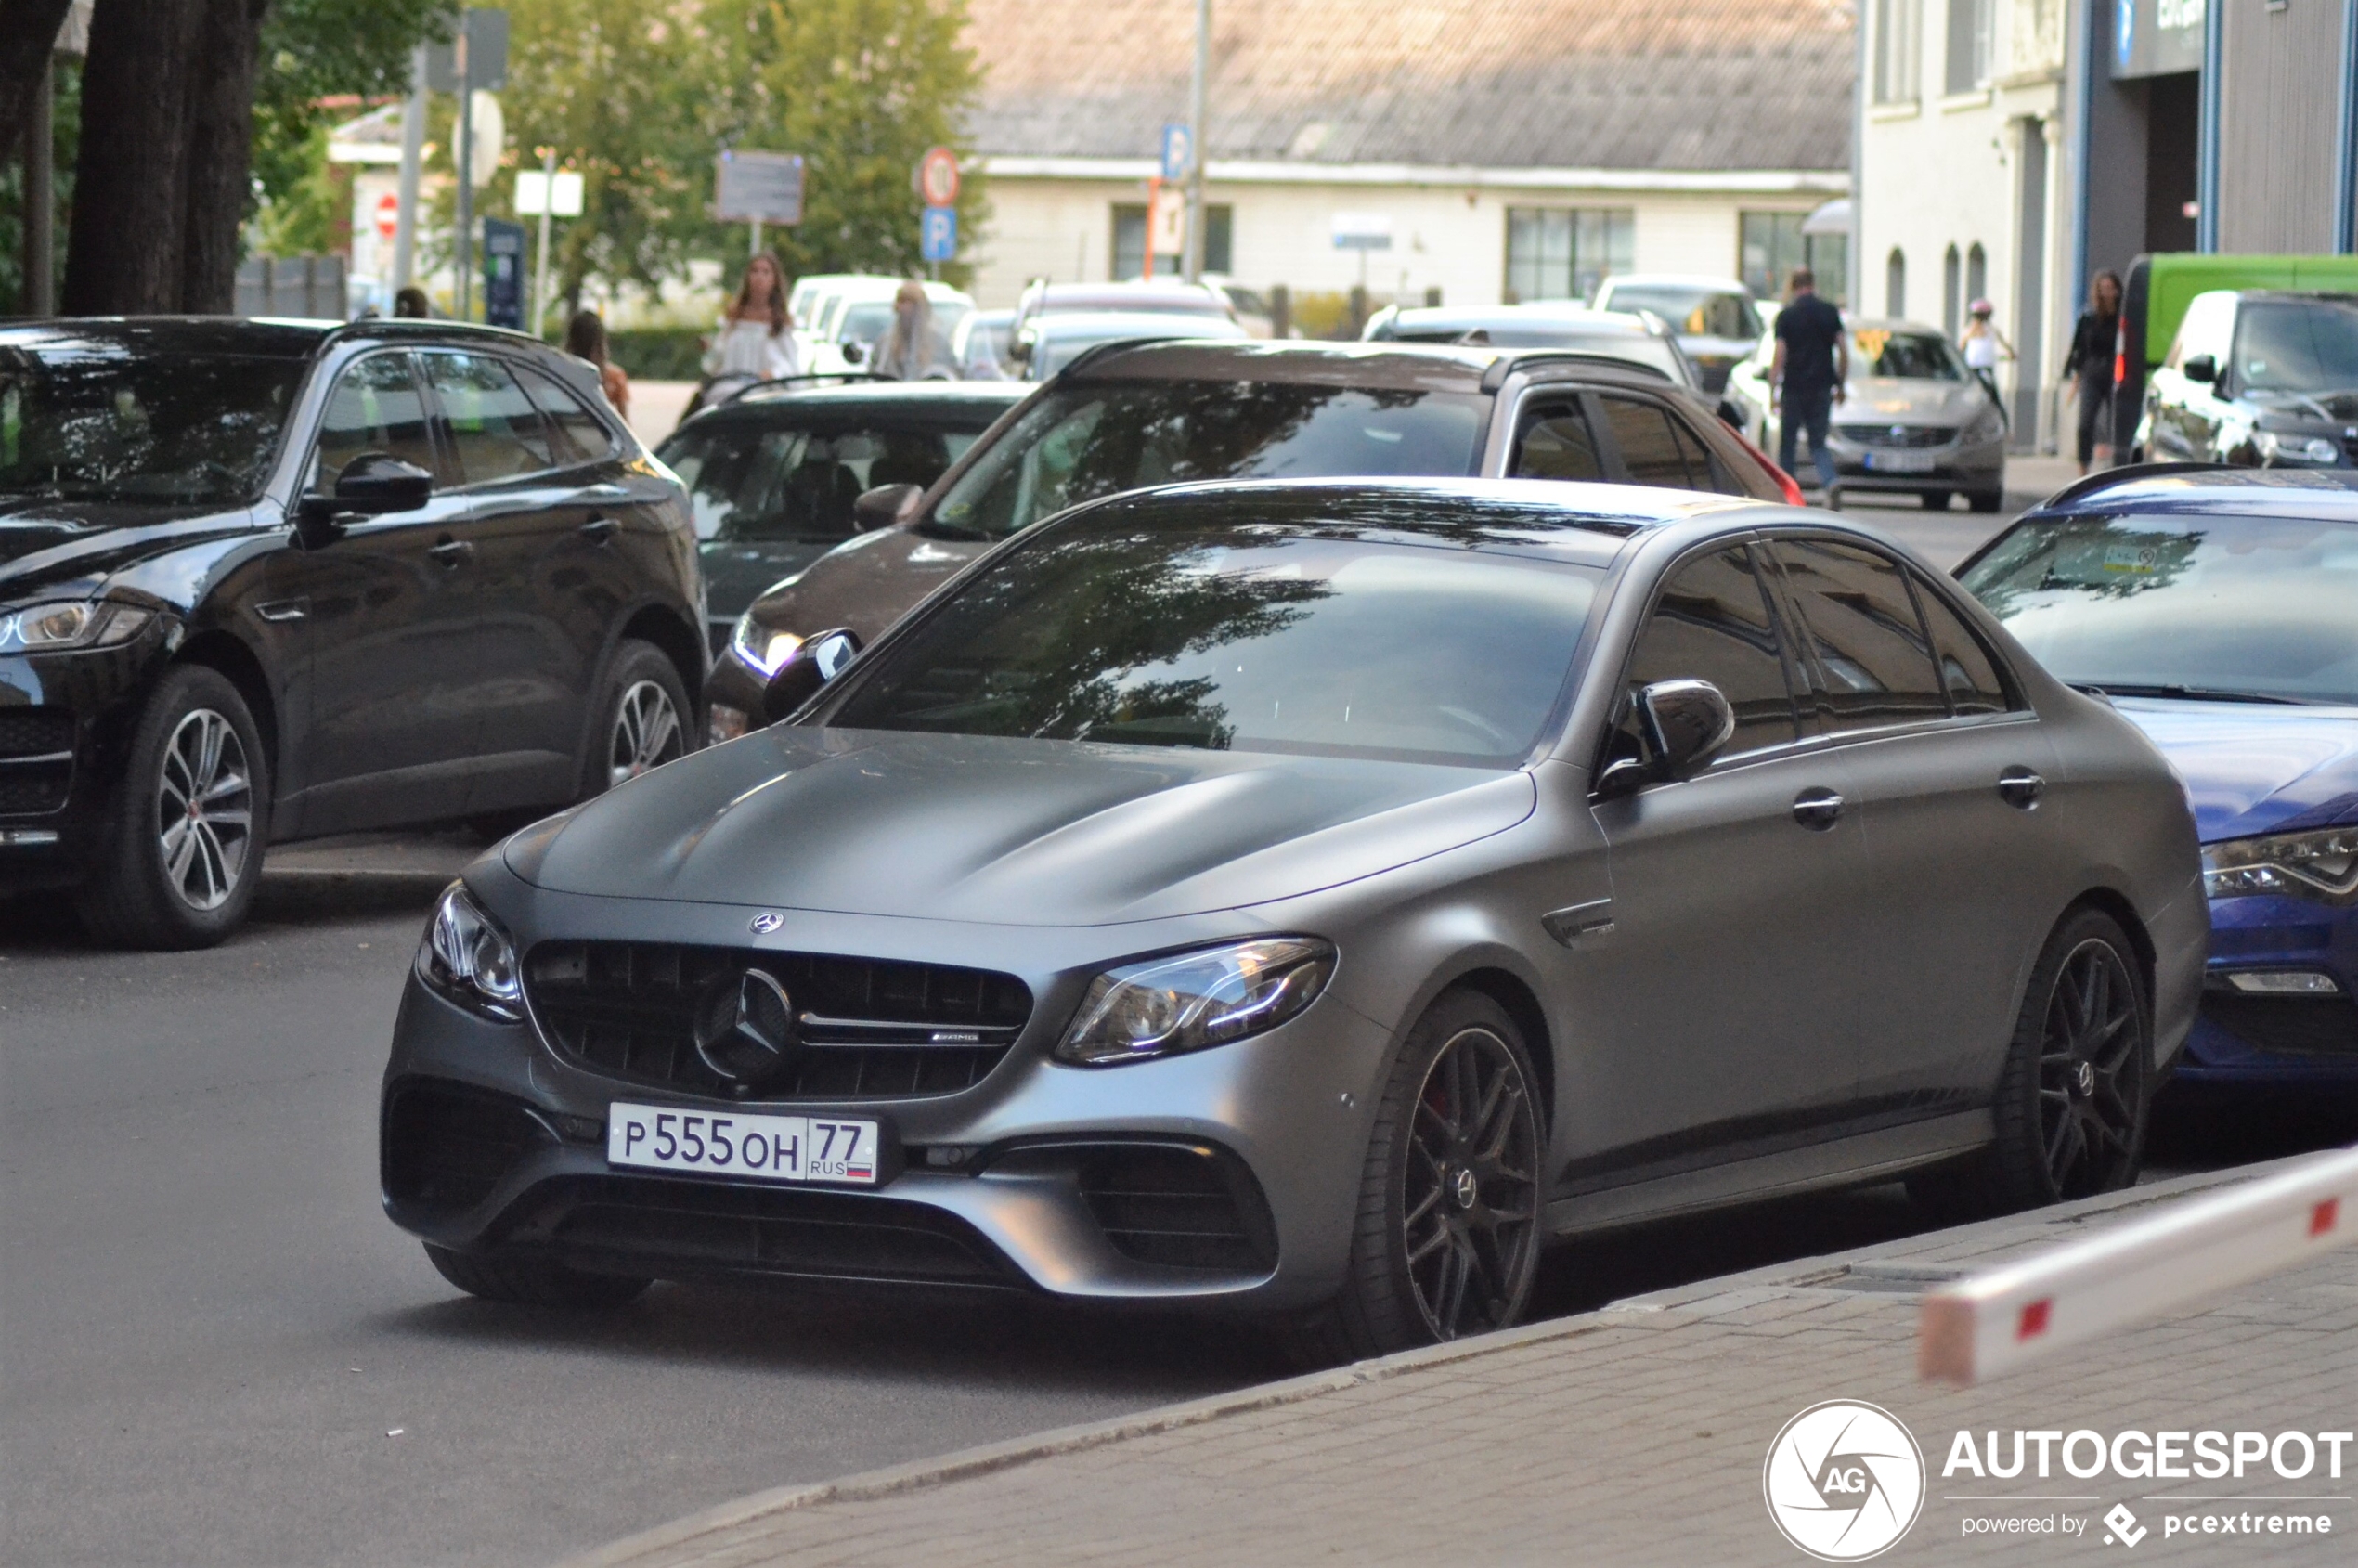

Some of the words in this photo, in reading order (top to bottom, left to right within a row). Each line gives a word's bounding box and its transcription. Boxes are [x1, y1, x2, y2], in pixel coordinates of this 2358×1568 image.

[930, 214, 950, 253] P
[815, 1123, 862, 1161] 77
[810, 1160, 846, 1176] RUS
